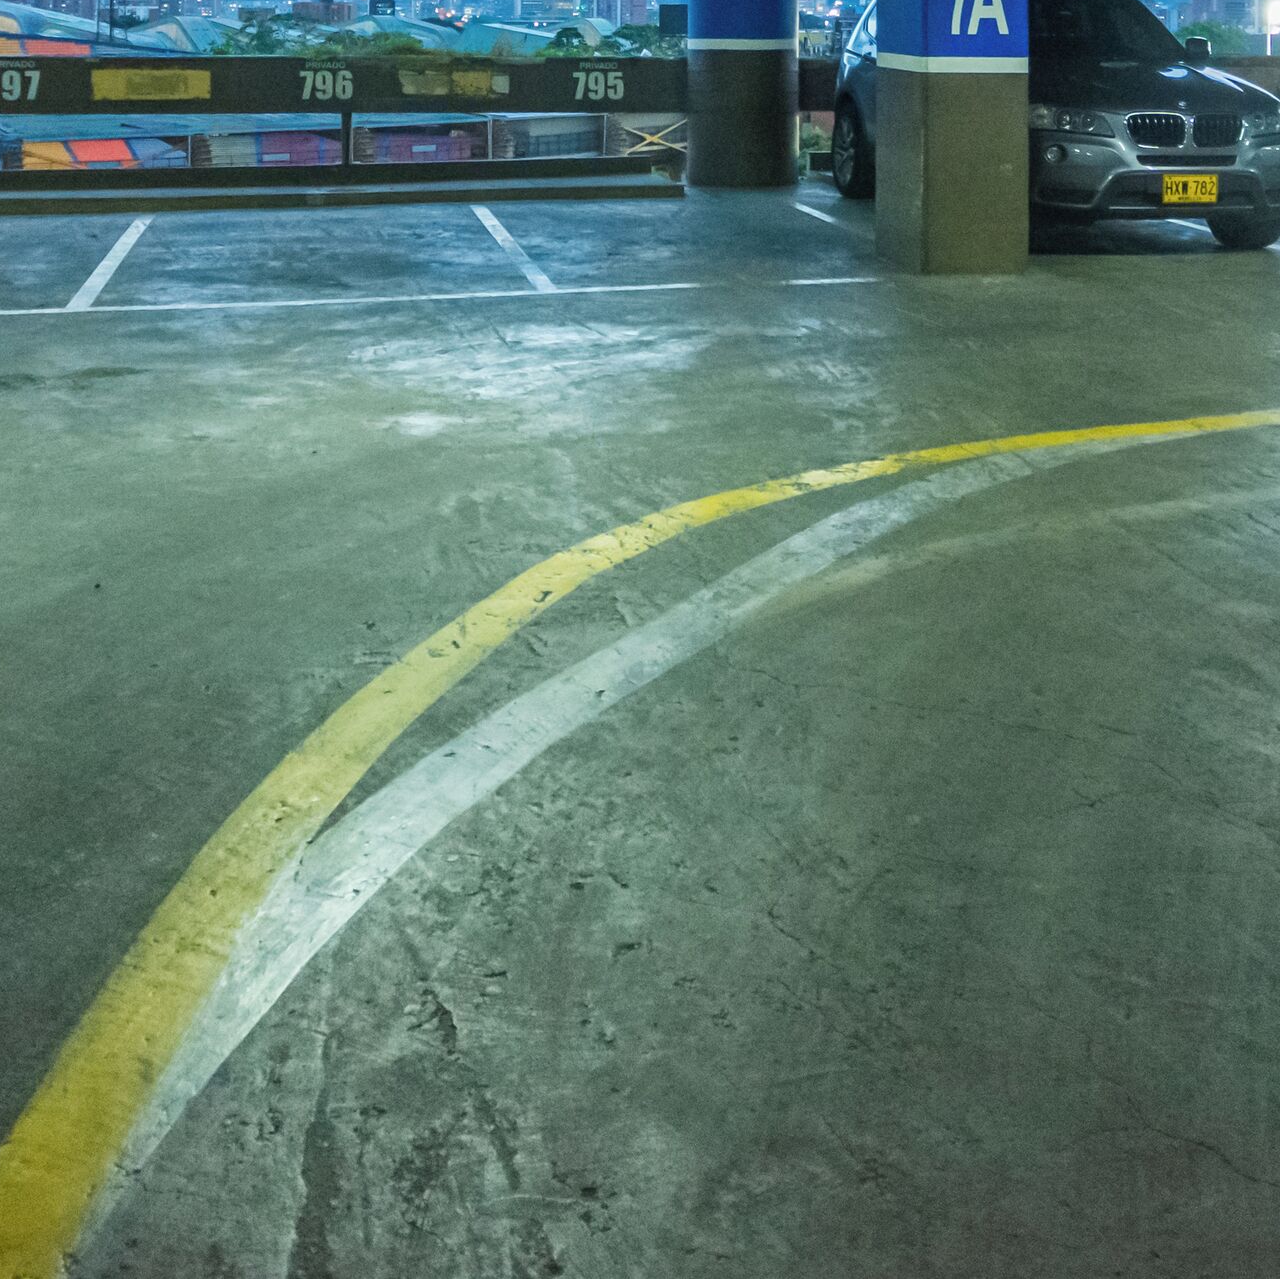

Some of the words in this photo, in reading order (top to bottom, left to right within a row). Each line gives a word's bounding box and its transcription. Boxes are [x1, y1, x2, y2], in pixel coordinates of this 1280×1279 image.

[305, 61, 347, 69] PRIVADO
[579, 62, 618, 70] PRIVADO
[299, 70, 353, 100] 796
[572, 71, 624, 100] 795
[1192, 180, 1216, 196] 782
